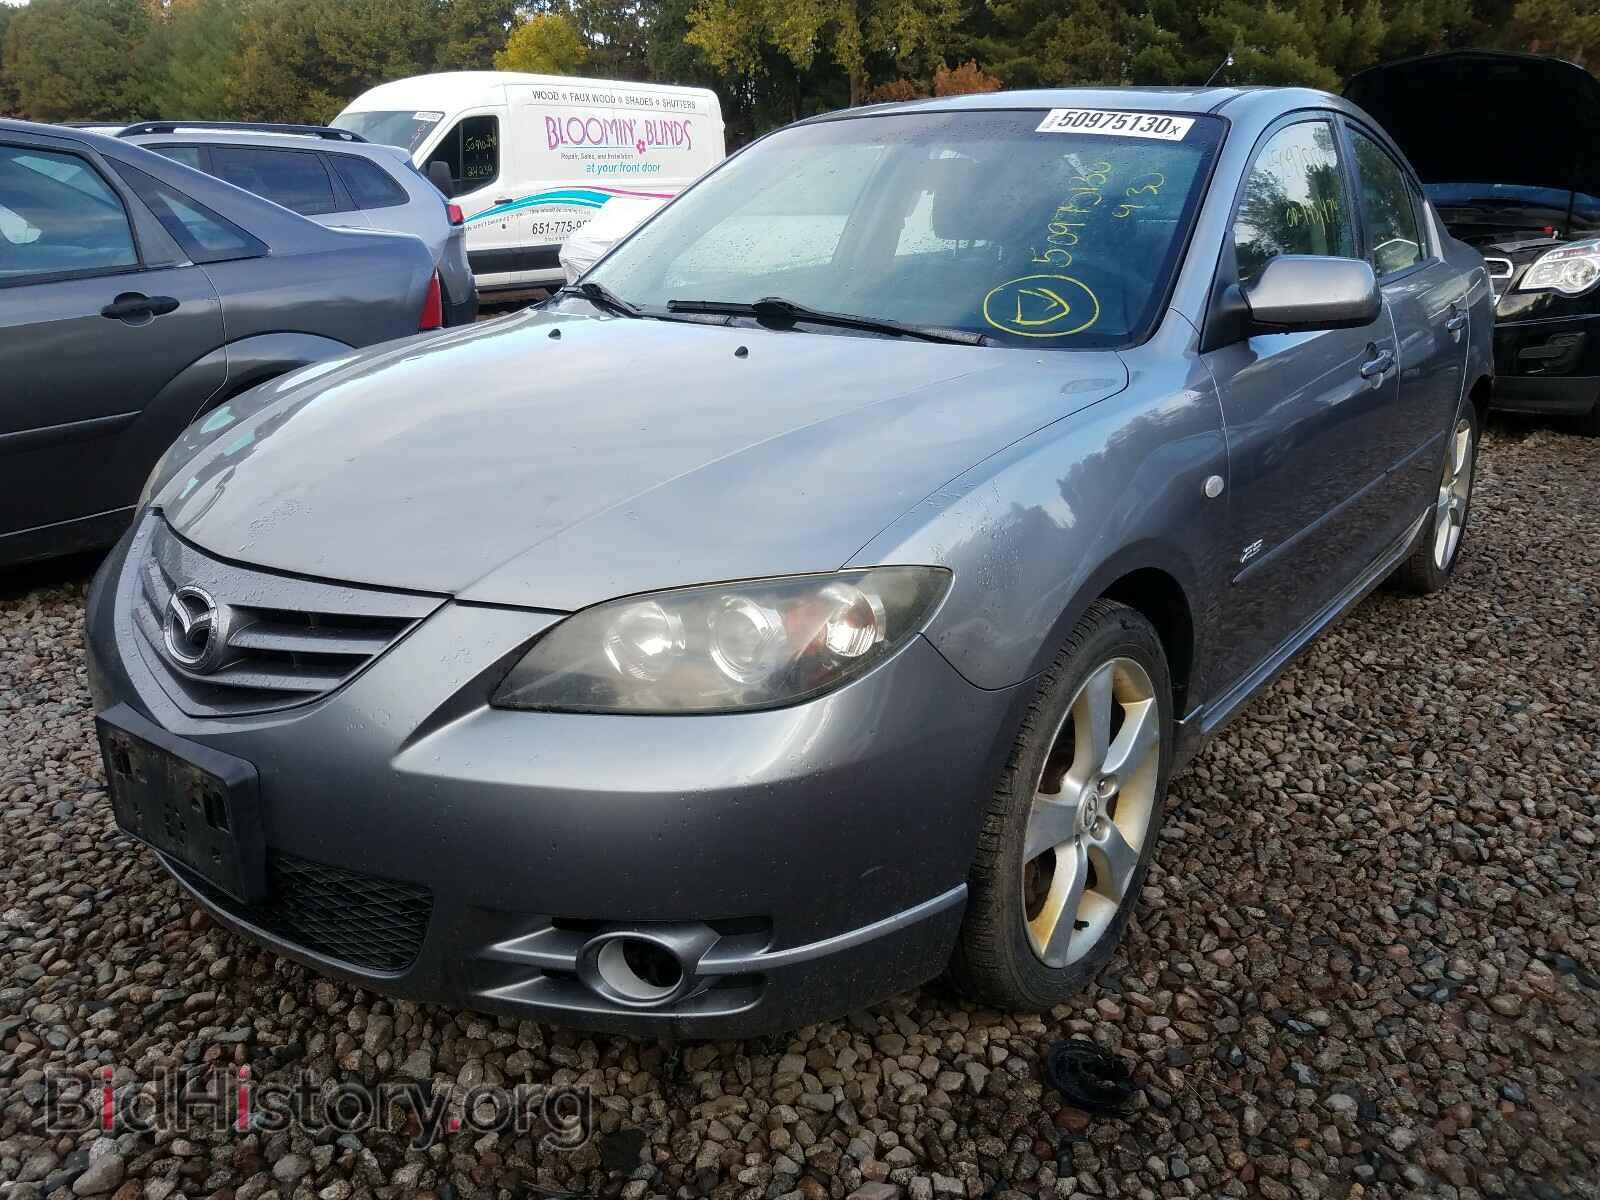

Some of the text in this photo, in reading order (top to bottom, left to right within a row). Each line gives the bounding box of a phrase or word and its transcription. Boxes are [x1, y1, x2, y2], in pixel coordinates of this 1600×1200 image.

[532, 90, 696, 110] WOOD FAUX WOOD SHADES SHUTTERS
[545, 116, 692, 151] BLOOMIN' BLINDS
[586, 161, 661, 175] at your front door
